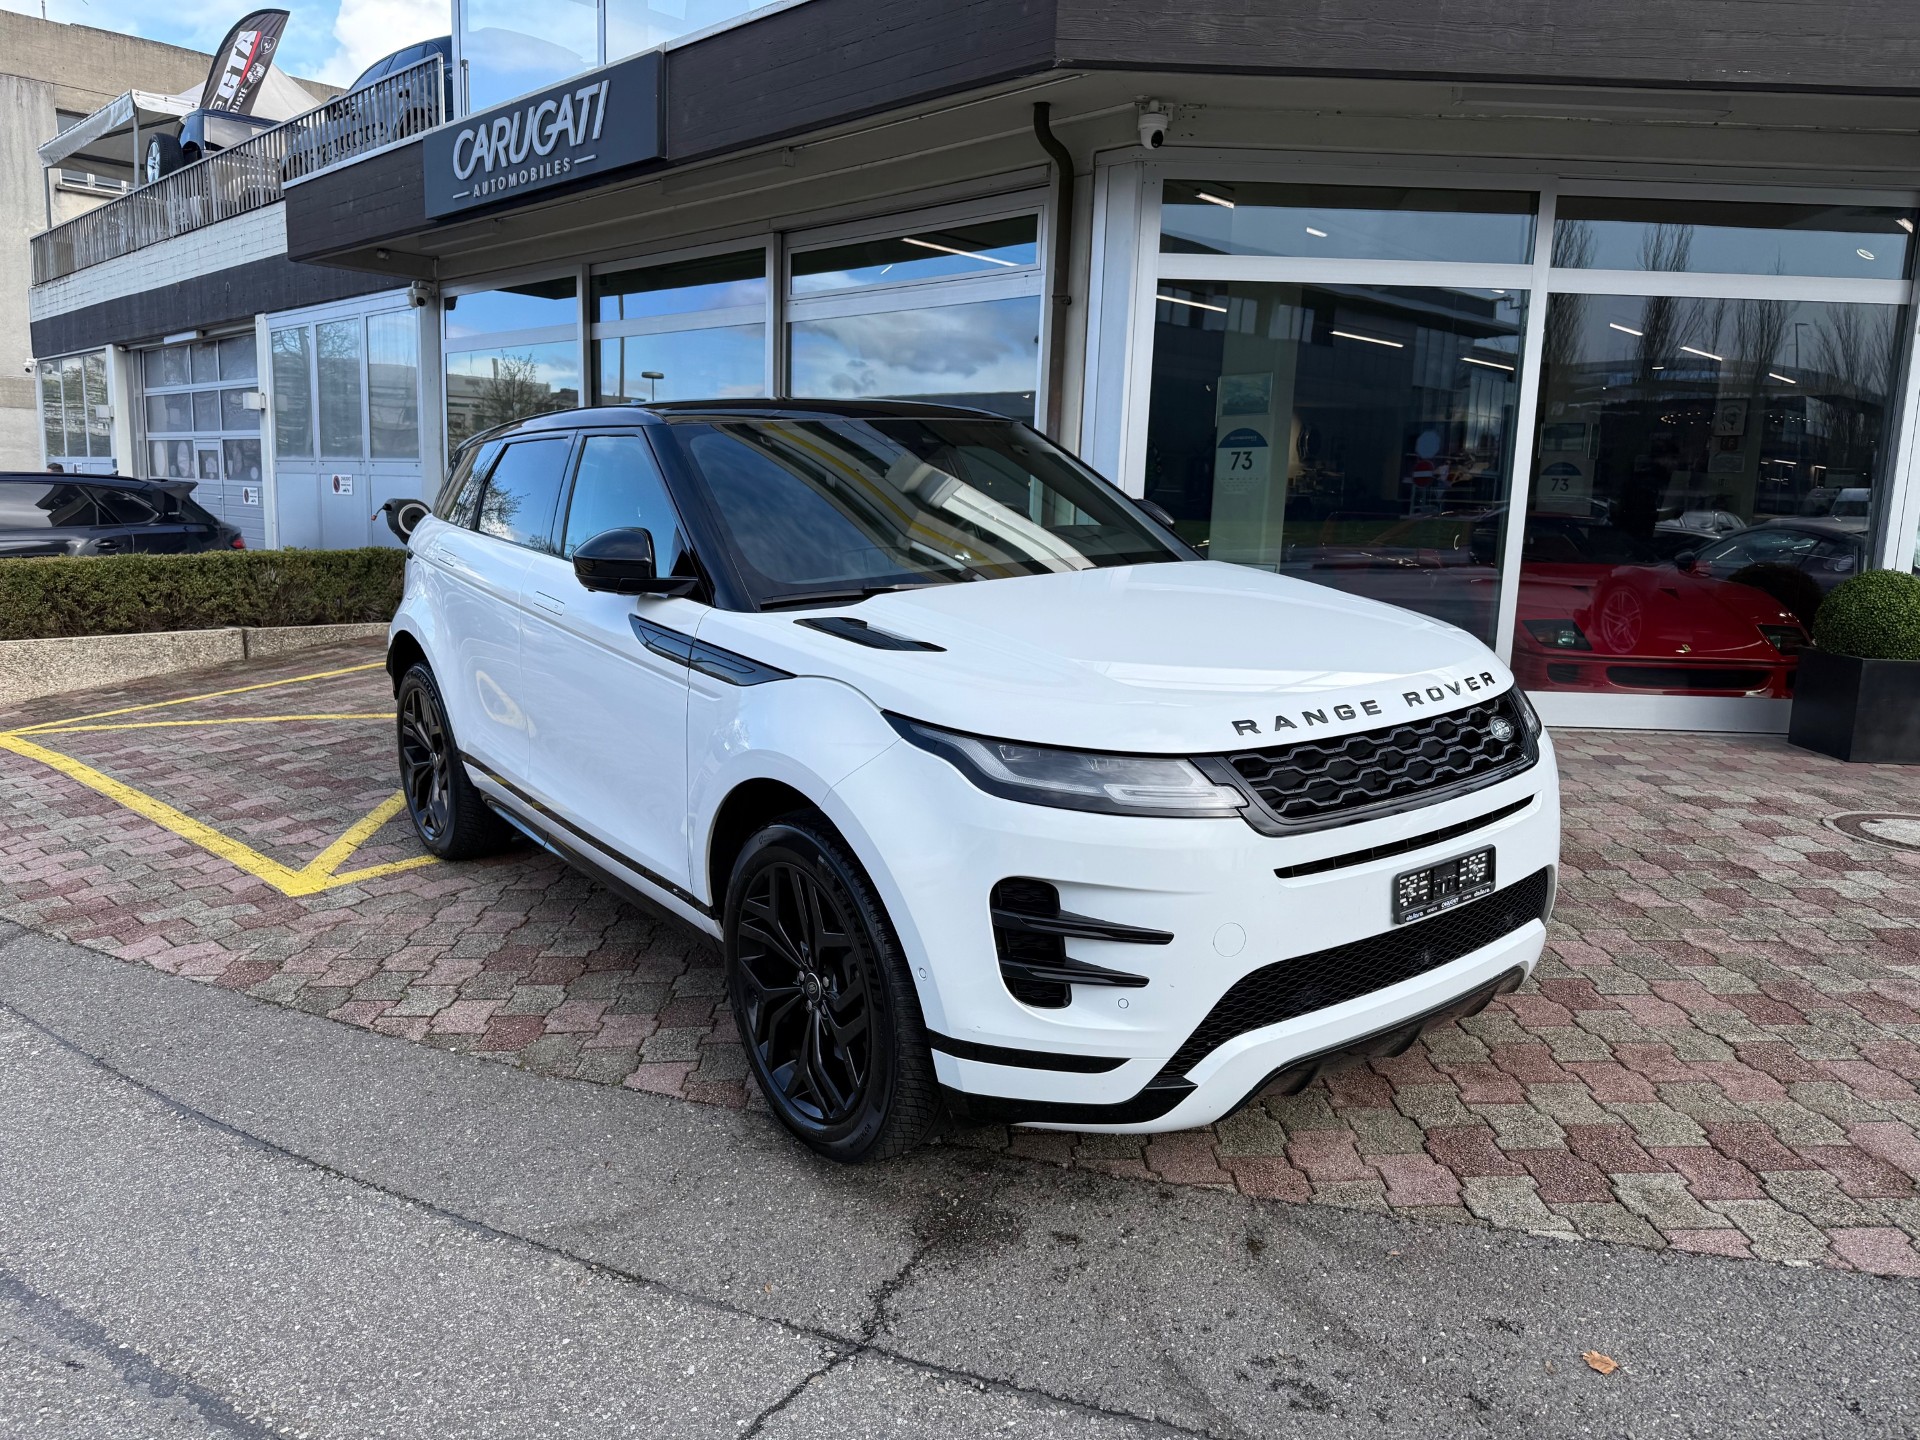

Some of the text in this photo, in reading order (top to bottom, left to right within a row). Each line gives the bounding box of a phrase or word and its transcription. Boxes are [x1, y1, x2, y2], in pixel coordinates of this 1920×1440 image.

[453, 79, 610, 181] CARUGATI
[473, 157, 572, 198] AUTOMOBILES
[1231, 451, 1253, 471] 73
[1551, 478, 1569, 492] 73
[1231, 671, 1496, 736] RANGE ROVER
